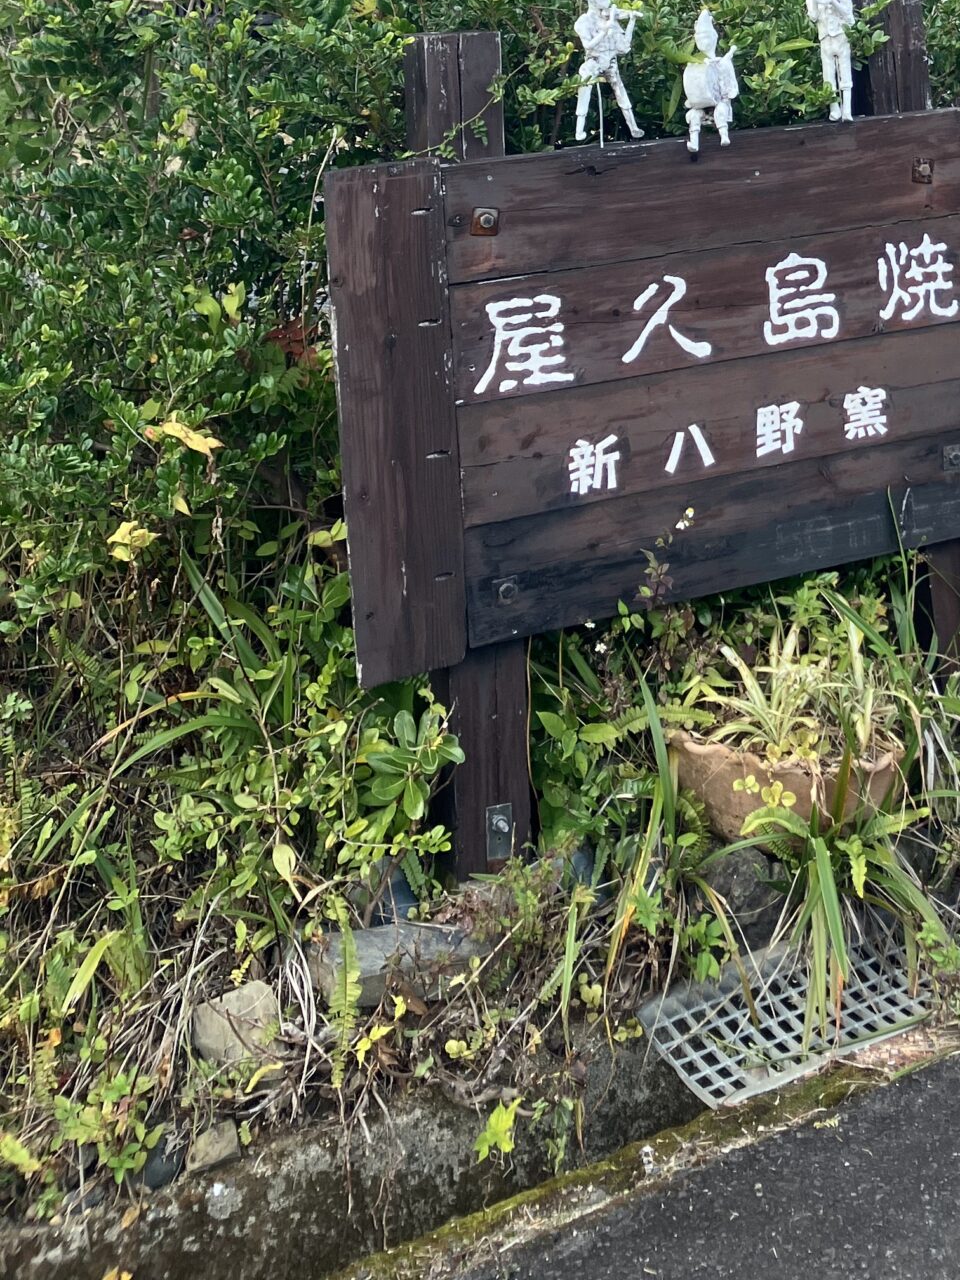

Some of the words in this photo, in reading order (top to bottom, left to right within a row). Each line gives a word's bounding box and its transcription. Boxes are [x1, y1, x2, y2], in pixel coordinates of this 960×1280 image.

[474, 233, 959, 394] 屋久島焼
[568, 386, 888, 495] 新八野窯
